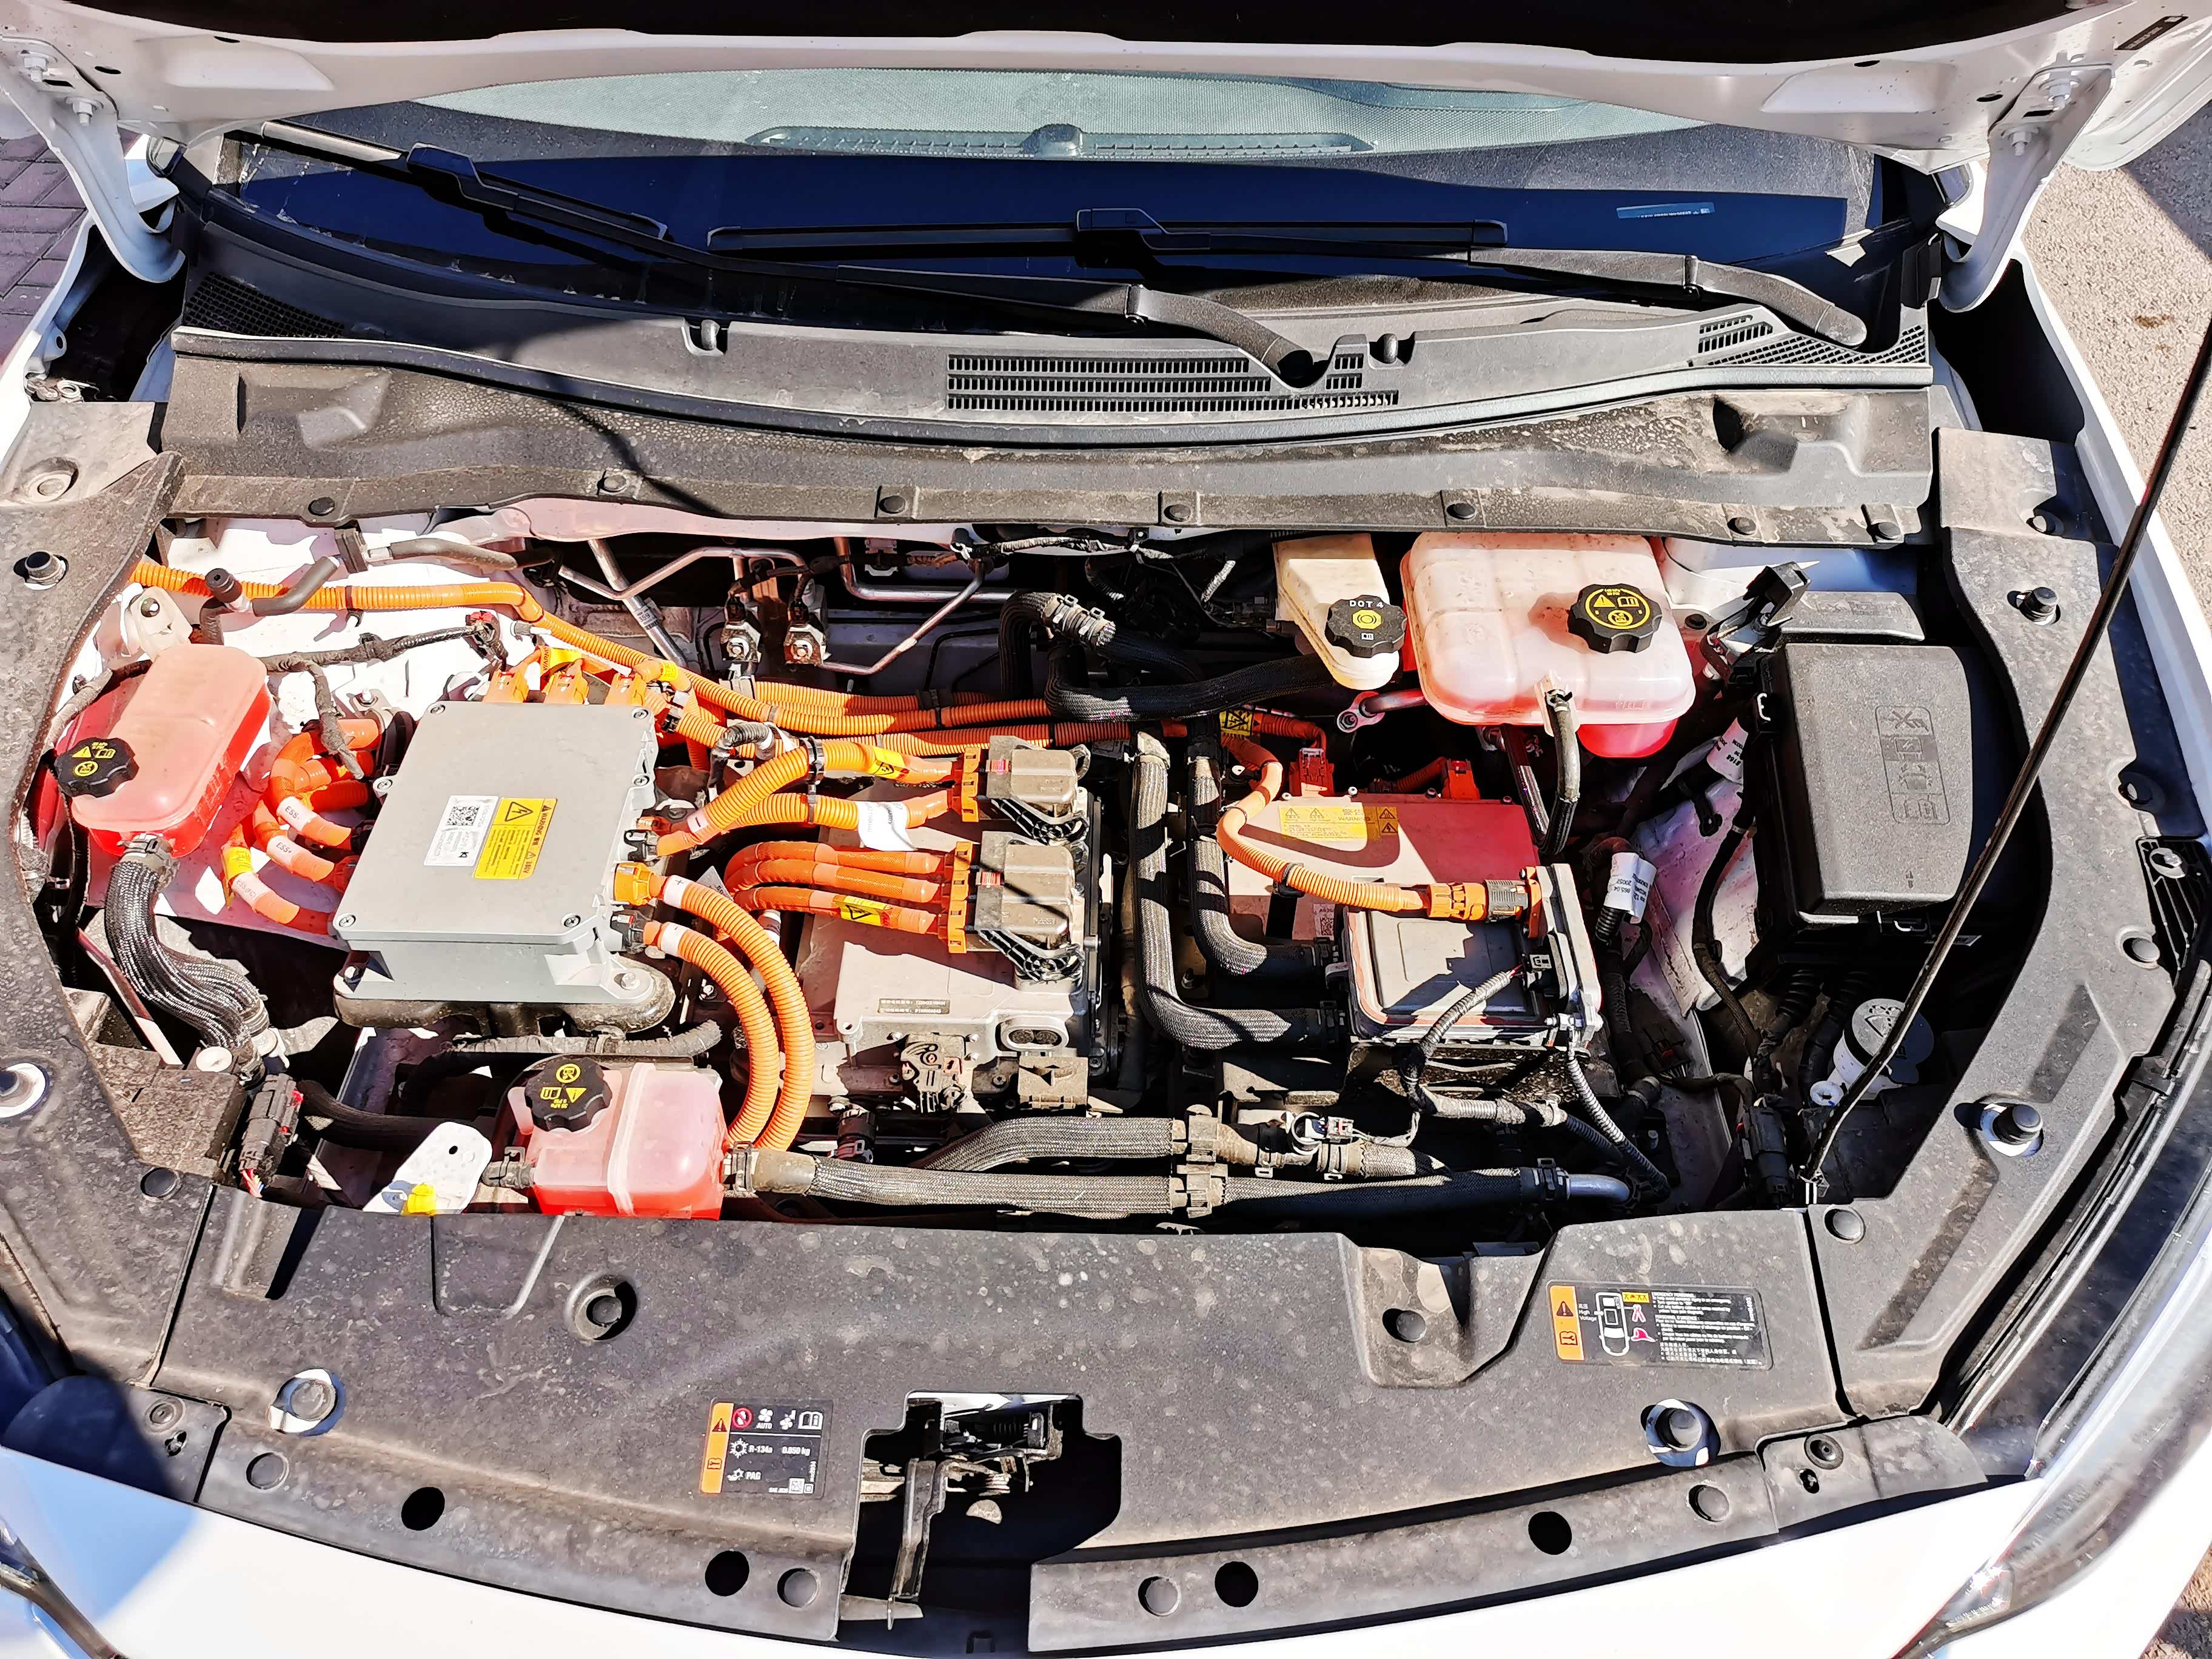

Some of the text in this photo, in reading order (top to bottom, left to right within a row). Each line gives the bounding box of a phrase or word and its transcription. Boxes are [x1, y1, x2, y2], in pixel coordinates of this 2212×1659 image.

[536, 813, 547, 835] WARNING
[748, 1445, 773, 1453] R-134a
[802, 1447, 811, 1456] kg
[746, 1471, 761, 1480] PAG
